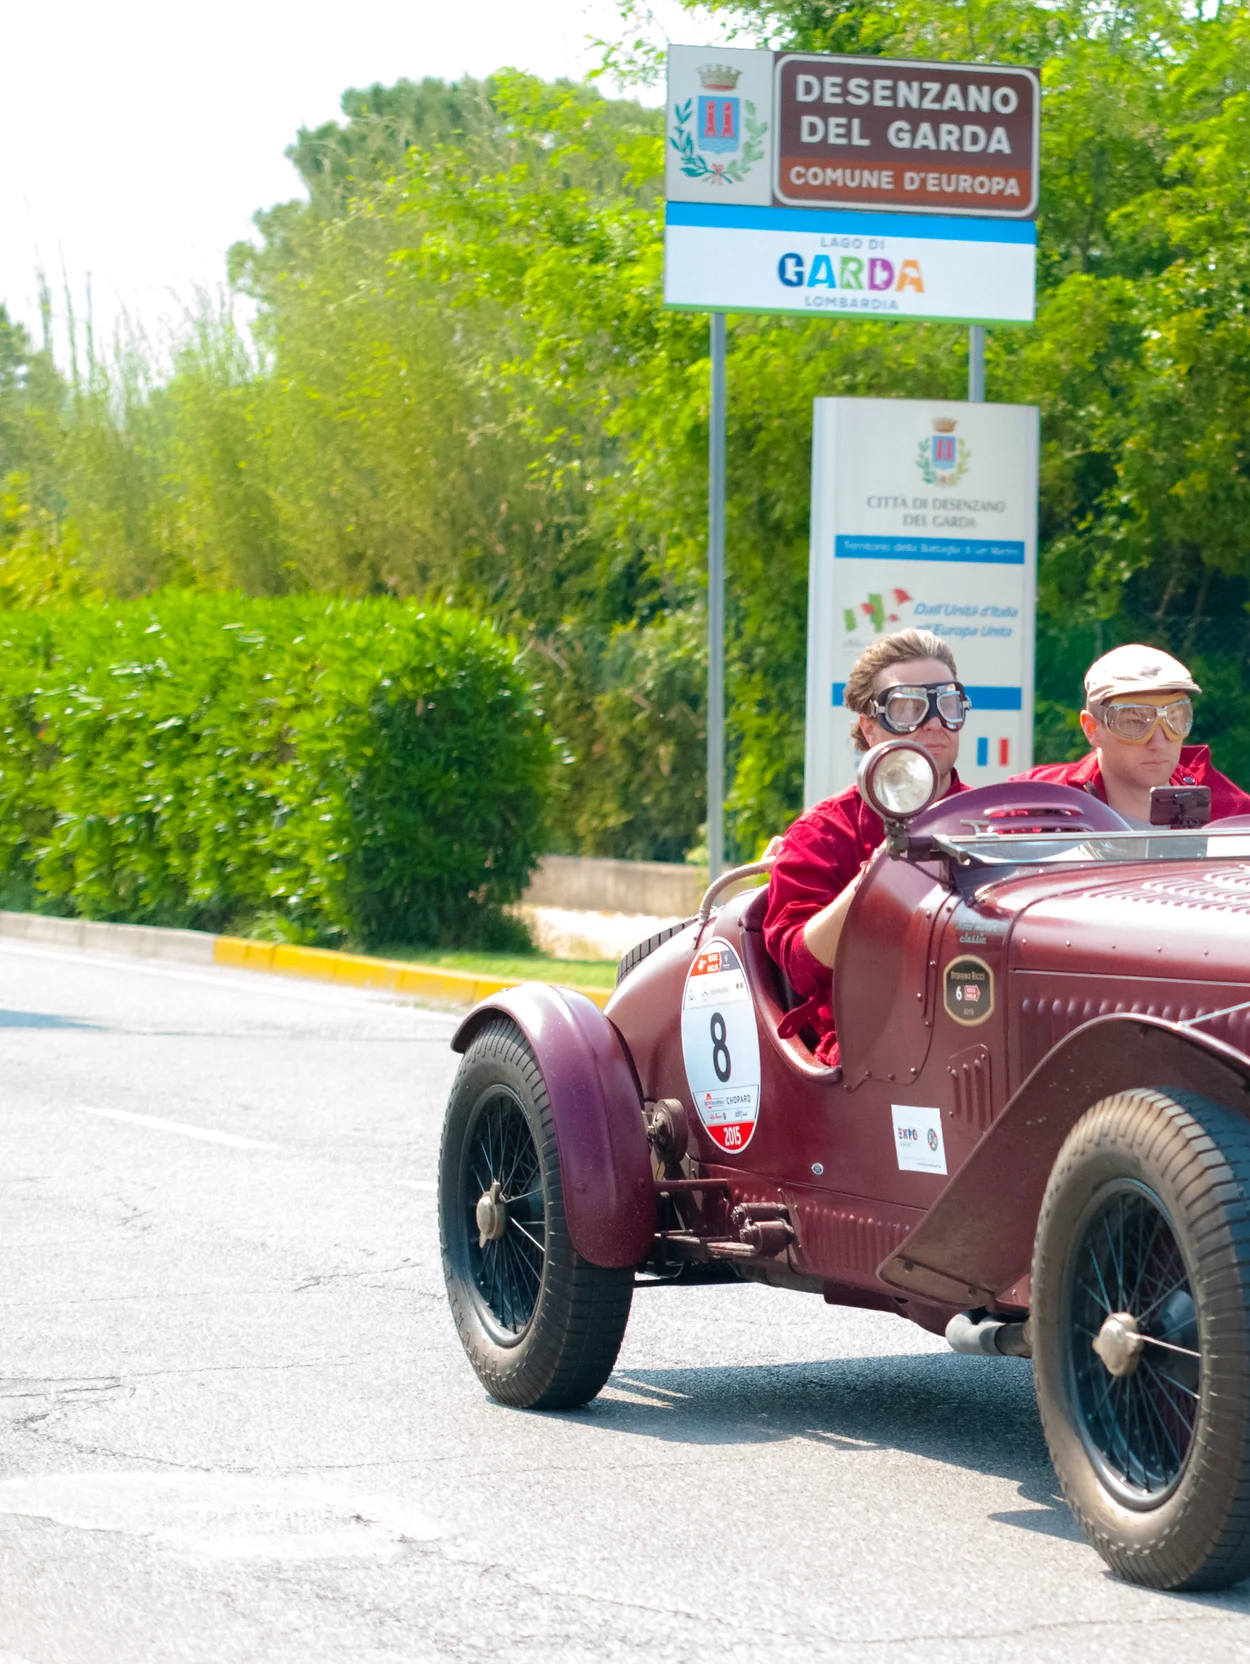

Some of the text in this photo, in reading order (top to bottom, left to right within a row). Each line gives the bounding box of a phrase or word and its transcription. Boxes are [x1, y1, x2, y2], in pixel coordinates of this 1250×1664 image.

[795, 74, 1019, 115] DESENZANO
[800, 115, 1012, 155] DEL GARDA
[789, 165, 1021, 197] COMUNE D'EUROPA
[820, 236, 886, 250] LAGO DI
[778, 252, 926, 294] GARDA
[804, 295, 899, 311] LOMBARDIA
[912, 497, 929, 510] DI
[931, 498, 1006, 515] DESENZANO
[902, 514, 977, 529] DEL GARDA
[955, 985, 963, 1001] 6
[710, 1012, 731, 1083] 8
[725, 1094, 752, 1105] CHOPARD
[723, 1125, 742, 1147] 2015
